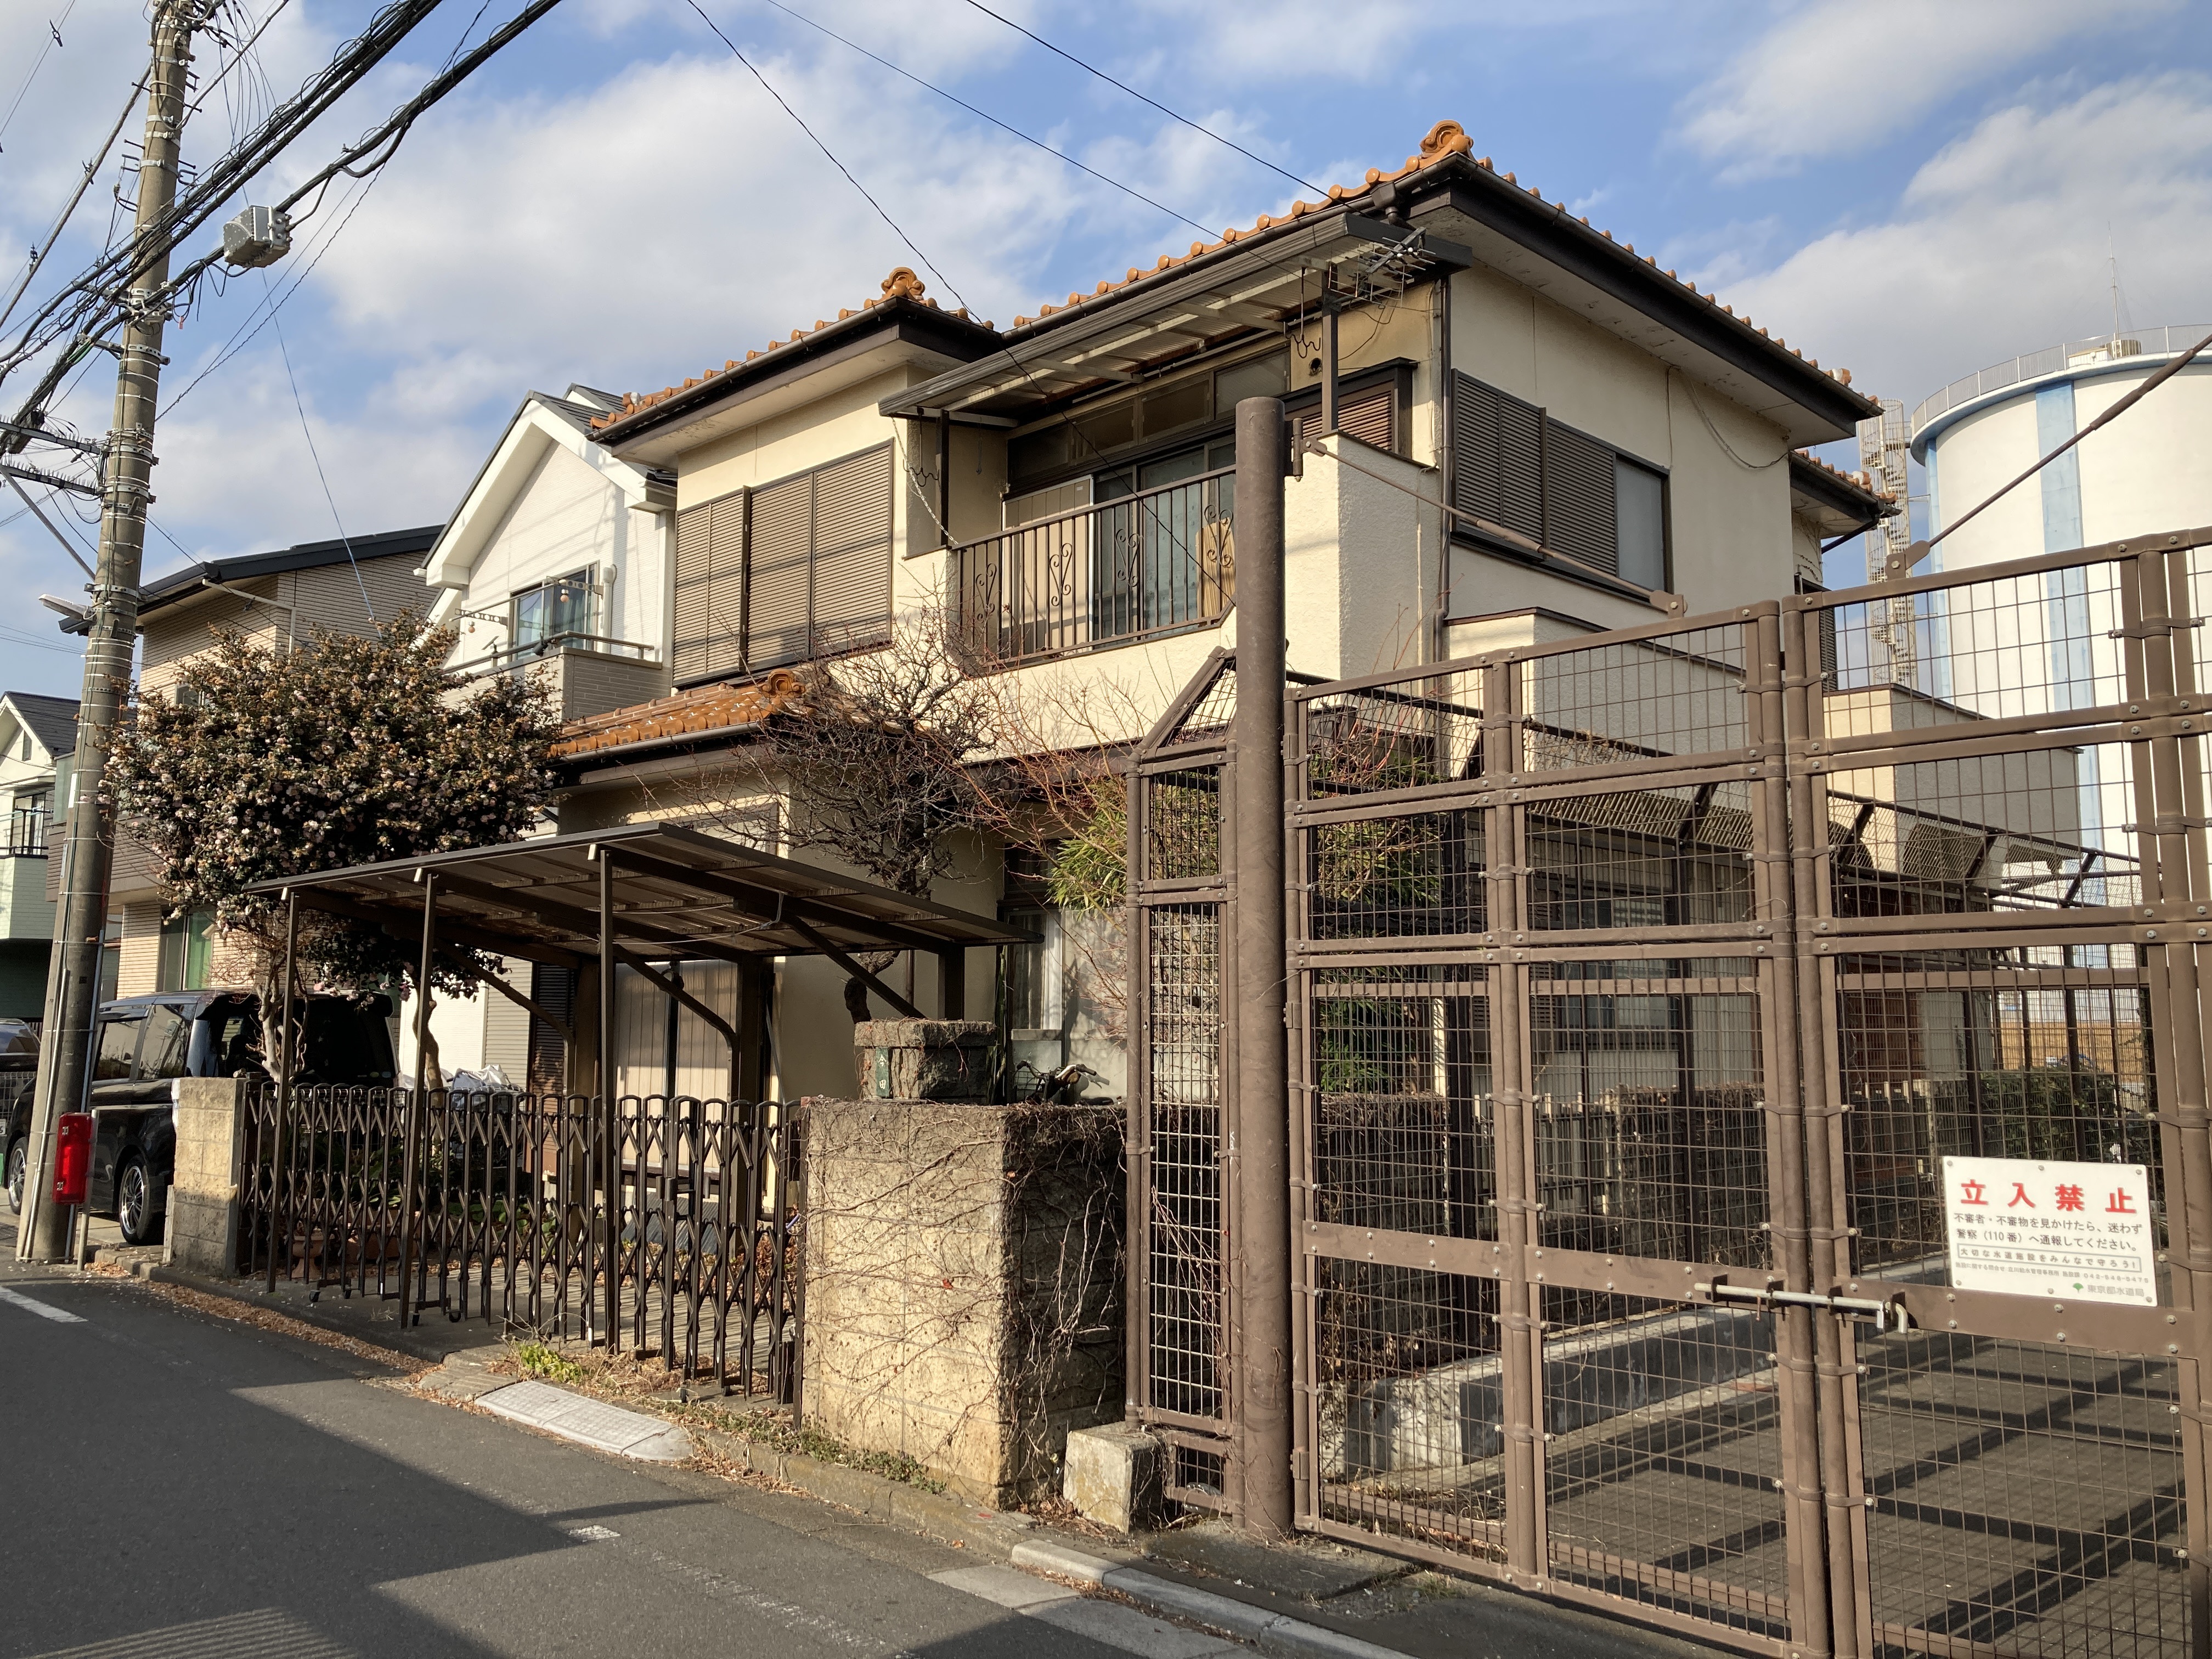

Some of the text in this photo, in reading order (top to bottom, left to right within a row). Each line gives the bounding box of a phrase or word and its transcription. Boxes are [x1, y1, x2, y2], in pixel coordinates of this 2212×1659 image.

[878, 1054, 888, 1090] 今田
[1960, 1179, 2137, 1214] 立入禁止
[1954, 1212, 2142, 1234] 不審者・不審物を見かけたら、迷わず
[2087, 1284, 2145, 1297] 東京都水道局
